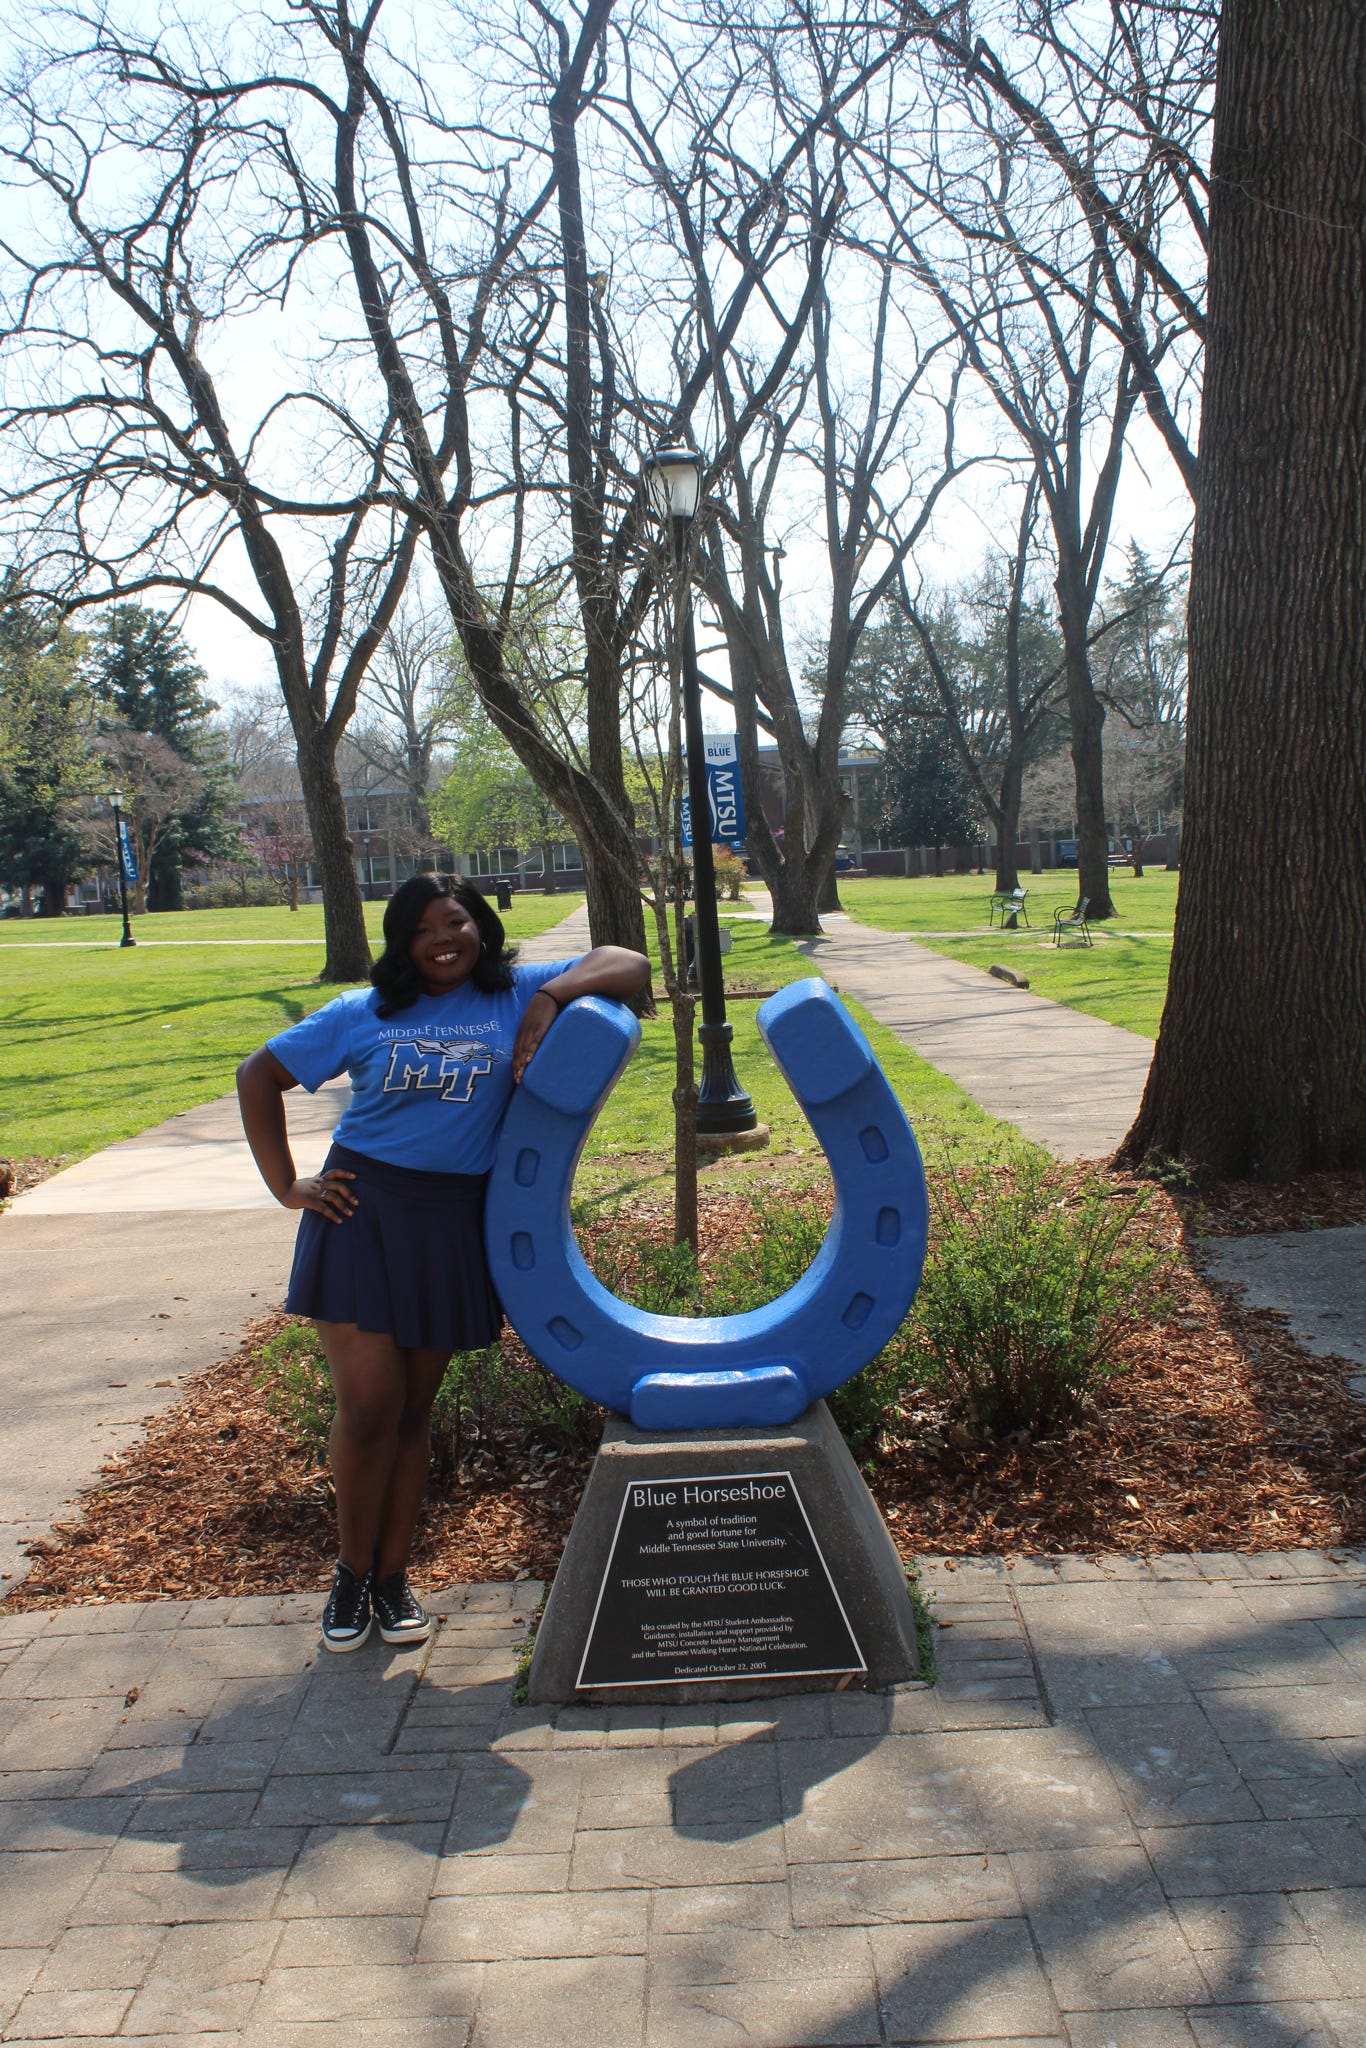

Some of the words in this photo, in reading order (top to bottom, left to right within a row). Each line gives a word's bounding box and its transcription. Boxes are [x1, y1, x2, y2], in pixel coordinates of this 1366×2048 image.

[707, 747, 731, 757] BLUE
[715, 770, 737, 836] MTSU
[378, 1024, 432, 1041] MIDDLE
[633, 1487, 677, 1507] Blue
[684, 1481, 786, 1504] Horseshoe
[666, 1519, 674, 1528] A
[675, 1517, 707, 1530] symbol
[709, 1516, 719, 1526] of
[720, 1514, 757, 1525] tradition
[667, 1531, 685, 1540] and
[686, 1529, 709, 1541] good
[711, 1527, 742, 1538] fortune
[744, 1526, 757, 1536] for
[639, 1544, 671, 1554] Middle
[672, 1542, 716, 1552] Tennessee
[718, 1540, 741, 1549] State
[741, 1537, 787, 1548] University.
[620, 1578, 650, 1588] THOSE
[651, 1576, 676, 1586] WHO
[679, 1574, 711, 1584] TOUCH
[712, 1572, 729, 1582] THE
[731, 1571, 754, 1581] BLUE
[669, 1587, 680, 1596] BE
[682, 1585, 726, 1596] GRANTED
[727, 1583, 757, 1593] GOOD
[759, 1581, 786, 1591] LUCK.
[641, 1623, 655, 1631] Idea
[656, 1621, 681, 1630] created
[681, 1621, 690, 1630] by
[691, 1620, 702, 1628] the
[703, 1619, 723, 1627] MTSU
[724, 1618, 749, 1626] Student
[643, 1631, 677, 1640] Guidance,
[715, 1628, 728, 1636] and
[728, 1627, 754, 1637] support
[754, 1624, 784, 1635] provided
[784, 1623, 793, 1633] by
[657, 1640, 679, 1648] MTSU
[679, 1639, 710, 1647] Concrete
[710, 1636, 737, 1646] Industry
[737, 1634, 780, 1644] Management
[631, 1651, 644, 1659] and
[645, 1650, 656, 1658] the
[656, 1649, 689, 1658] Tennessee
[690, 1646, 718, 1656] Walking
[718, 1645, 738, 1654] Horse
[739, 1643, 767, 1653] National
[674, 1665, 708, 1674] Dedicated
[709, 1663, 736, 1673] October
[750, 1661, 767, 1670] 2005
